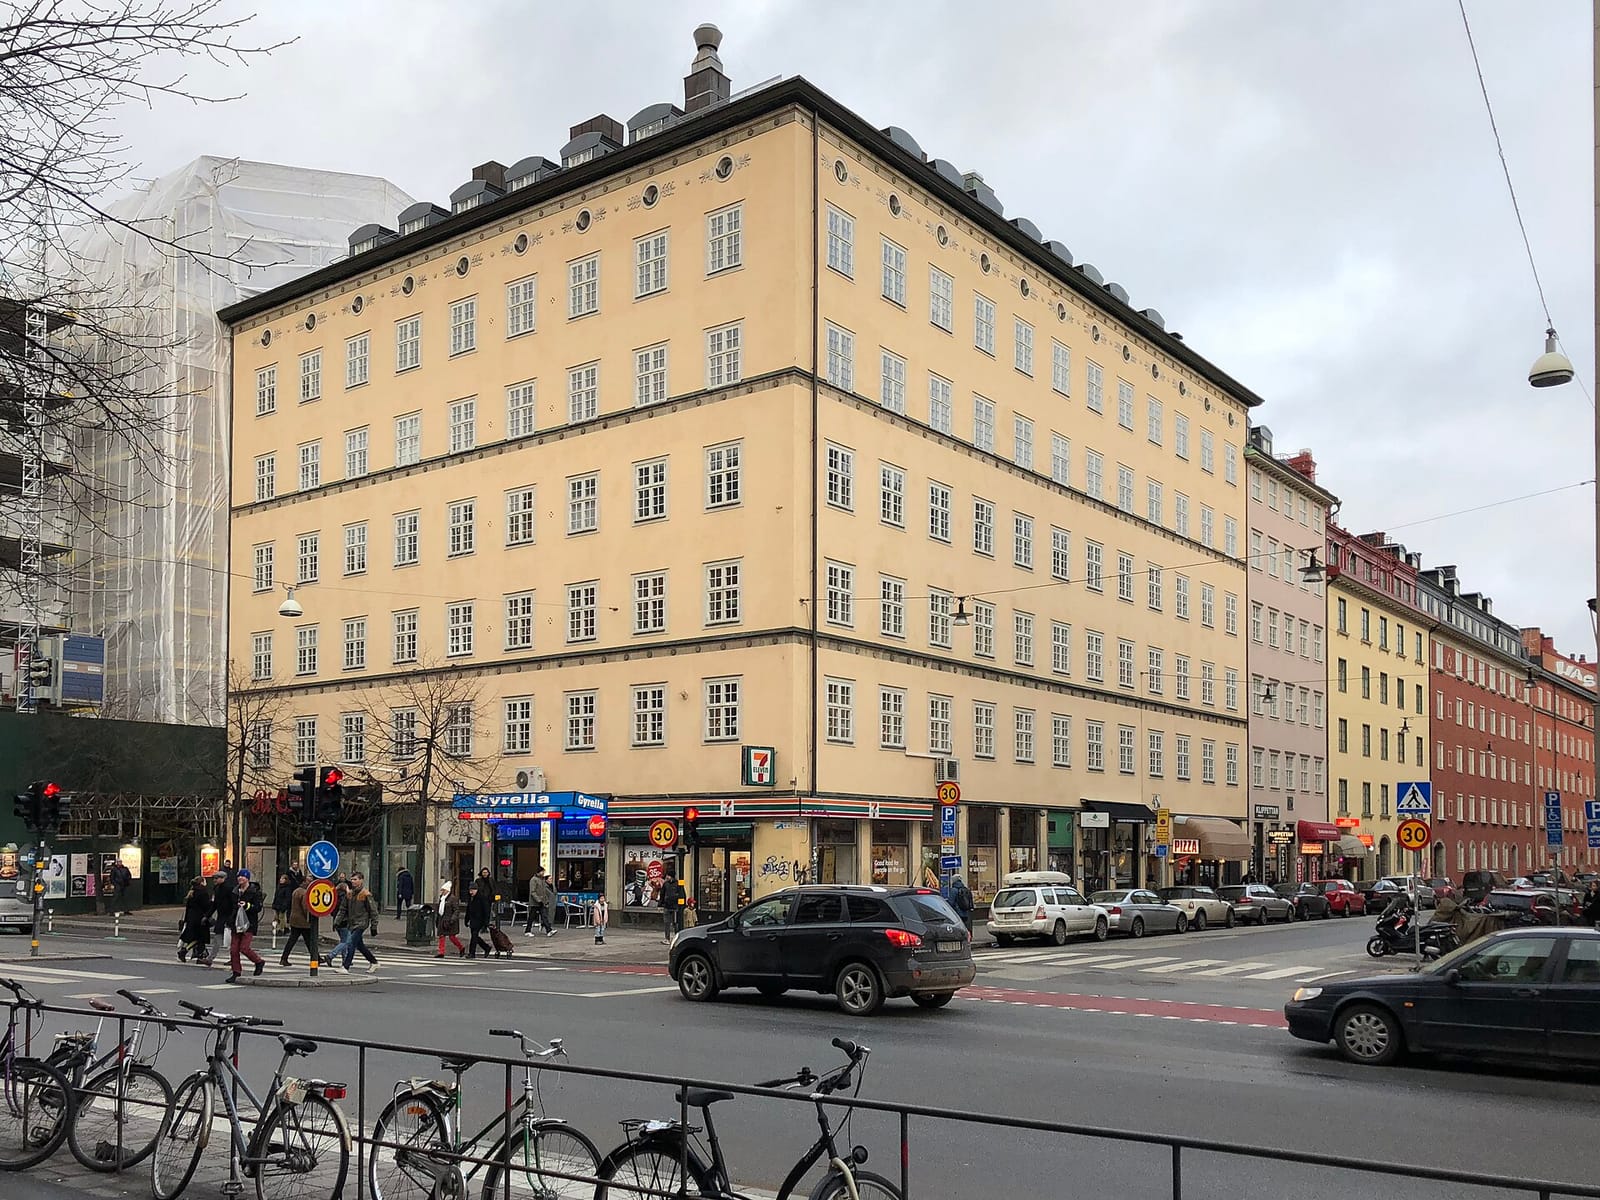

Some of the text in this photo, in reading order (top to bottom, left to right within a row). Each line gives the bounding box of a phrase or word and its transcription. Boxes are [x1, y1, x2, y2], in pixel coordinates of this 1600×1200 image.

[475, 793, 550, 807] Gyrella
[942, 787, 957, 800] 30
[1548, 793, 1558, 806] P
[578, 794, 604, 810] Gyrella
[945, 808, 953, 820] P
[1591, 801, 1600, 818] P
[506, 827, 530, 838] Gyrella
[654, 827, 673, 841] 30
[1403, 827, 1426, 842] 30
[1174, 839, 1198, 853] PIZZA
[311, 888, 333, 907] 30
